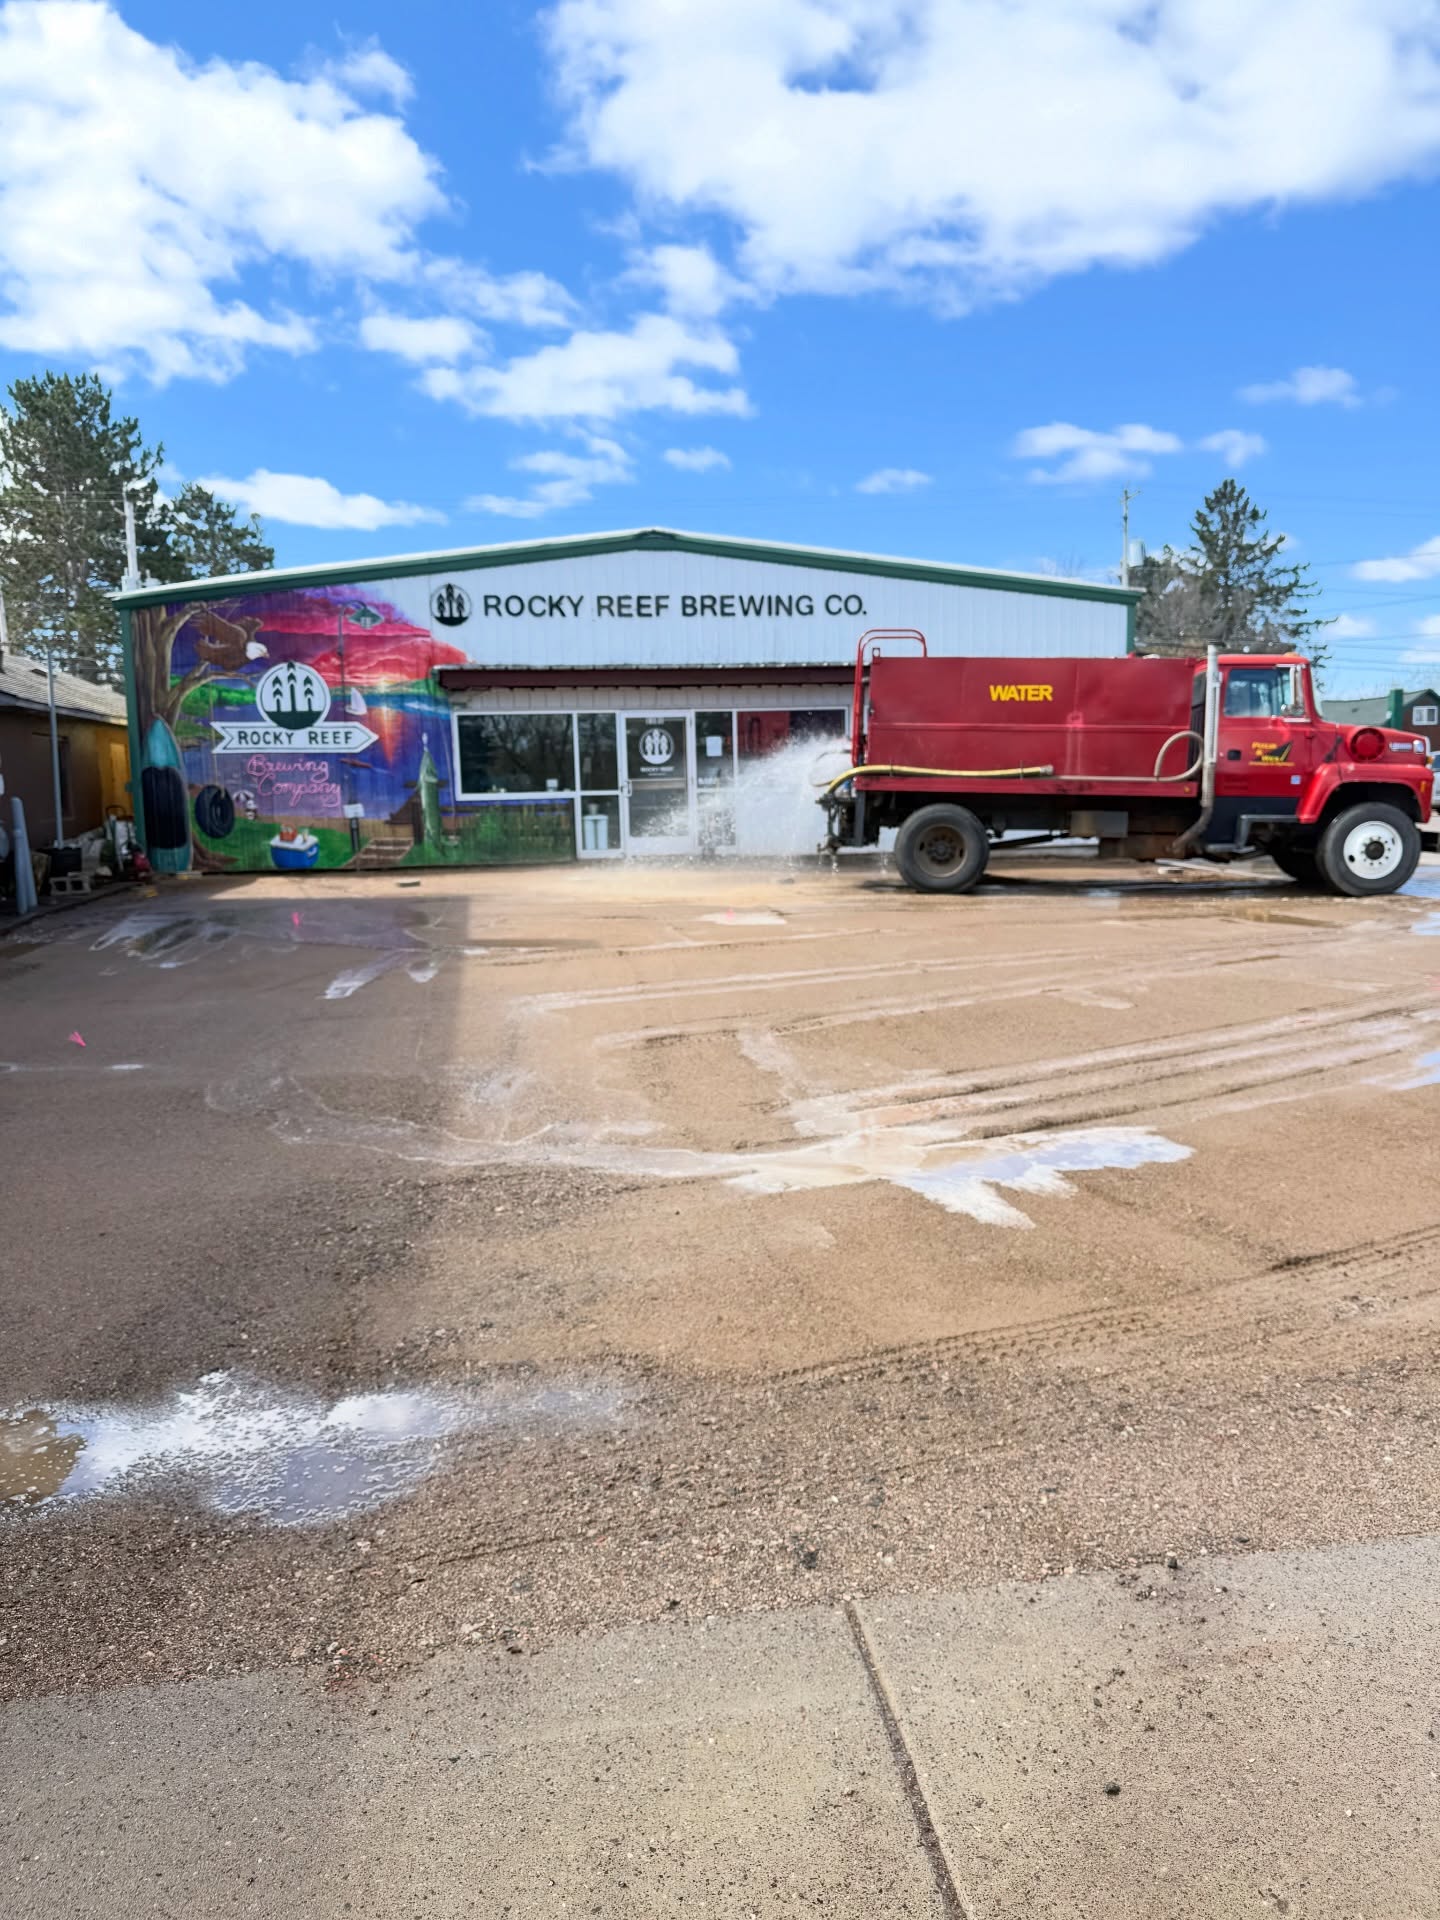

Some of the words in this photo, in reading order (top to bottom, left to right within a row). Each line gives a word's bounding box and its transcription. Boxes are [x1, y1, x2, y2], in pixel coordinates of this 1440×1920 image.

[483, 594, 584, 618] ROCKY
[596, 594, 670, 618] REEF
[681, 594, 814, 618] BREWING
[824, 594, 867, 616] CO.
[989, 684, 1053, 702] WATER
[238, 730, 294, 746] ROCKY
[308, 730, 353, 746] REEF
[247, 754, 329, 783] Brewing
[257, 773, 341, 807] Company
